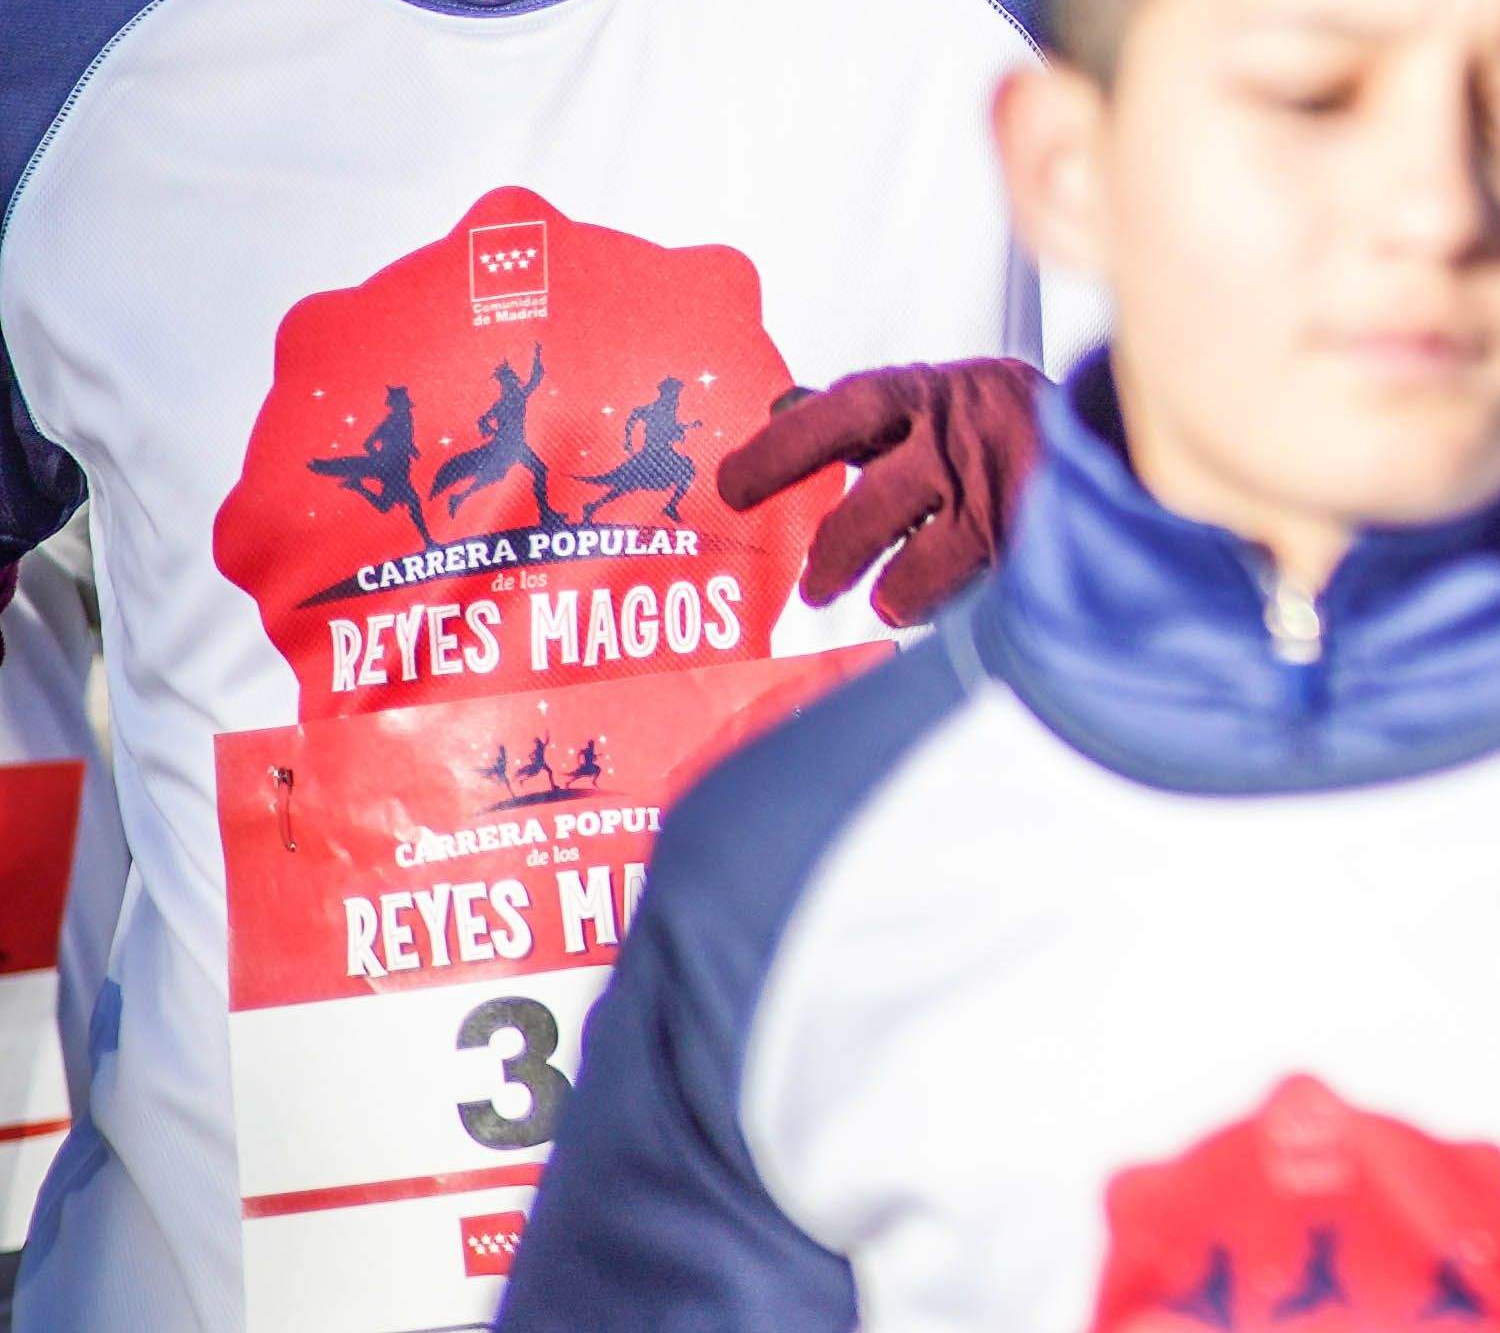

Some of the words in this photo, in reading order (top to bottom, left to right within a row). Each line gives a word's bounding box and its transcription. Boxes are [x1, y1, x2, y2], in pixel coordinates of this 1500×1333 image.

[472, 296, 548, 314] Comunidad
[473, 314, 491, 326] de
[495, 307, 548, 323] Madrid
[356, 537, 518, 591] CARRERA
[527, 529, 699, 559] POPULAR
[490, 572, 515, 593] de
[520, 570, 548, 590] los
[328, 599, 502, 693] REYES
[530, 575, 743, 671] MAGOS
[394, 818, 548, 868] CARRERA
[554, 807, 664, 840] POPUL
[526, 848, 550, 868] de
[553, 845, 580, 864] los
[343, 879, 533, 979] REYES
